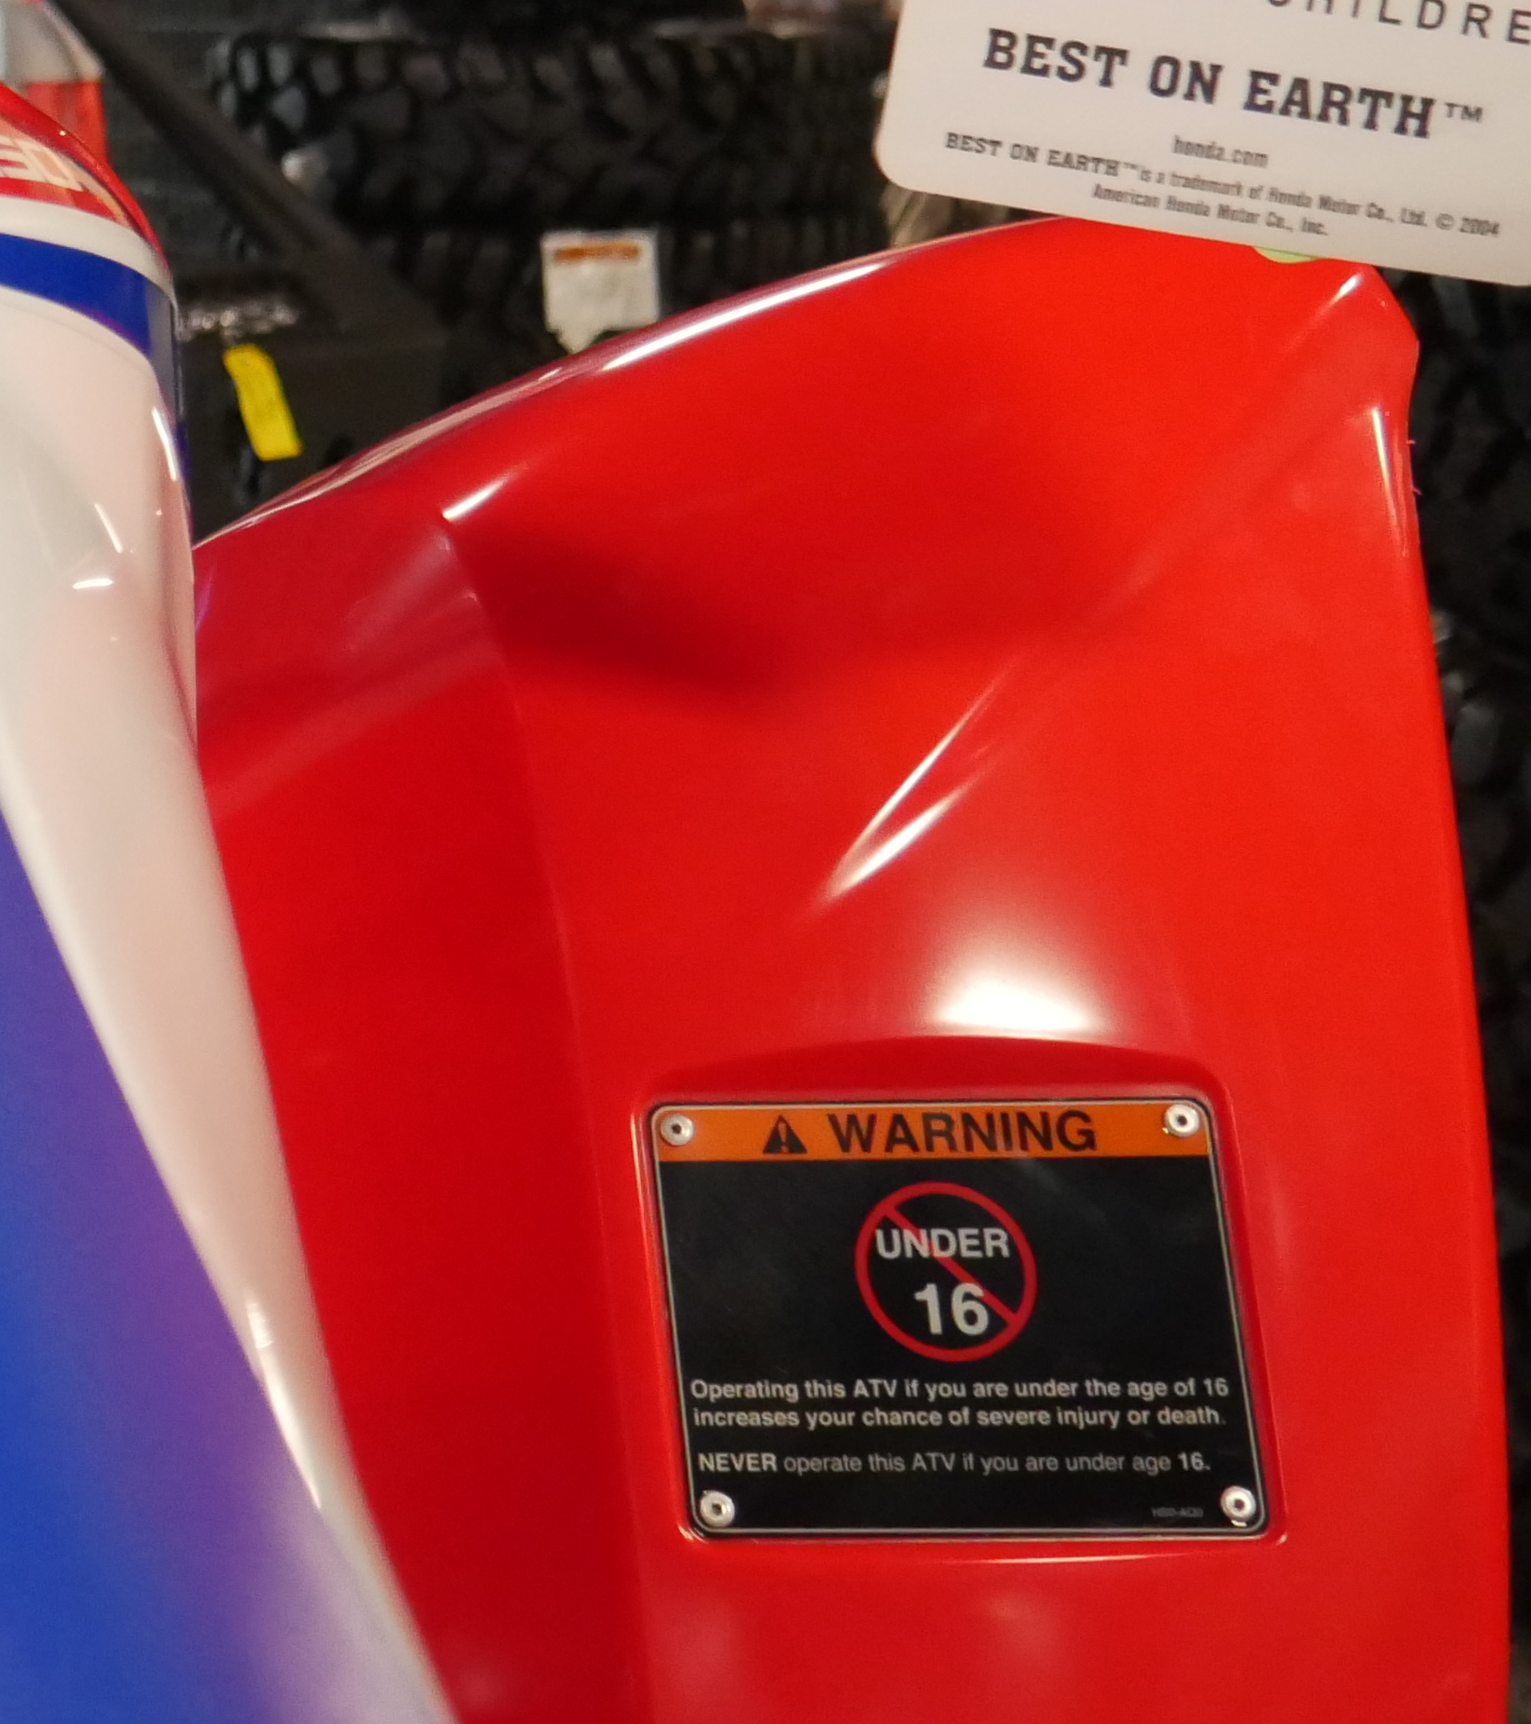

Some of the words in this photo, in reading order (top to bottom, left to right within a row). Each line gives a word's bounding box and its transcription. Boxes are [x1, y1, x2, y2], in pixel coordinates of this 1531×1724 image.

[983, 27, 1129, 88] BEST
[1148, 54, 1224, 105] ON
[1243, 69, 1437, 139] EARTH
[945, 131, 1003, 157] BEST
[1009, 143, 1040, 163] ON
[1046, 149, 1121, 177] EARTH
[828, 1110, 1097, 1155] WARNING
[875, 1227, 1012, 1261] UNDER
[913, 1282, 991, 1337] 16
[690, 1378, 799, 1403] Operating
[804, 1379, 846, 1398] this
[853, 1378, 897, 1398] ATV
[904, 1378, 919, 1397] if
[924, 1382, 967, 1402] you
[973, 1382, 1009, 1398] are
[1014, 1378, 1079, 1397] under
[1084, 1378, 1121, 1397] the
[1127, 1381, 1168, 1401] age
[1173, 1377, 1195, 1397] of
[1203, 1377, 1229, 1397] 16
[693, 1407, 800, 1427] increases
[805, 1410, 856, 1430] your
[862, 1407, 943, 1427] chance
[948, 1406, 970, 1426] of
[976, 1410, 1051, 1426] severe
[1057, 1406, 1120, 1429] injury
[1127, 1409, 1150, 1425] or
[698, 1452, 778, 1473] NEVER
[783, 1454, 862, 1476] operate
[868, 1453, 906, 1472] this
[912, 1451, 956, 1472] ATV
[963, 1452, 974, 1471] if
[980, 1456, 1019, 1475] you
[1025, 1456, 1059, 1471] are
[1065, 1453, 1125, 1472] under
[1132, 1456, 1171, 1474] age
[1178, 1451, 1211, 1471] 16.
